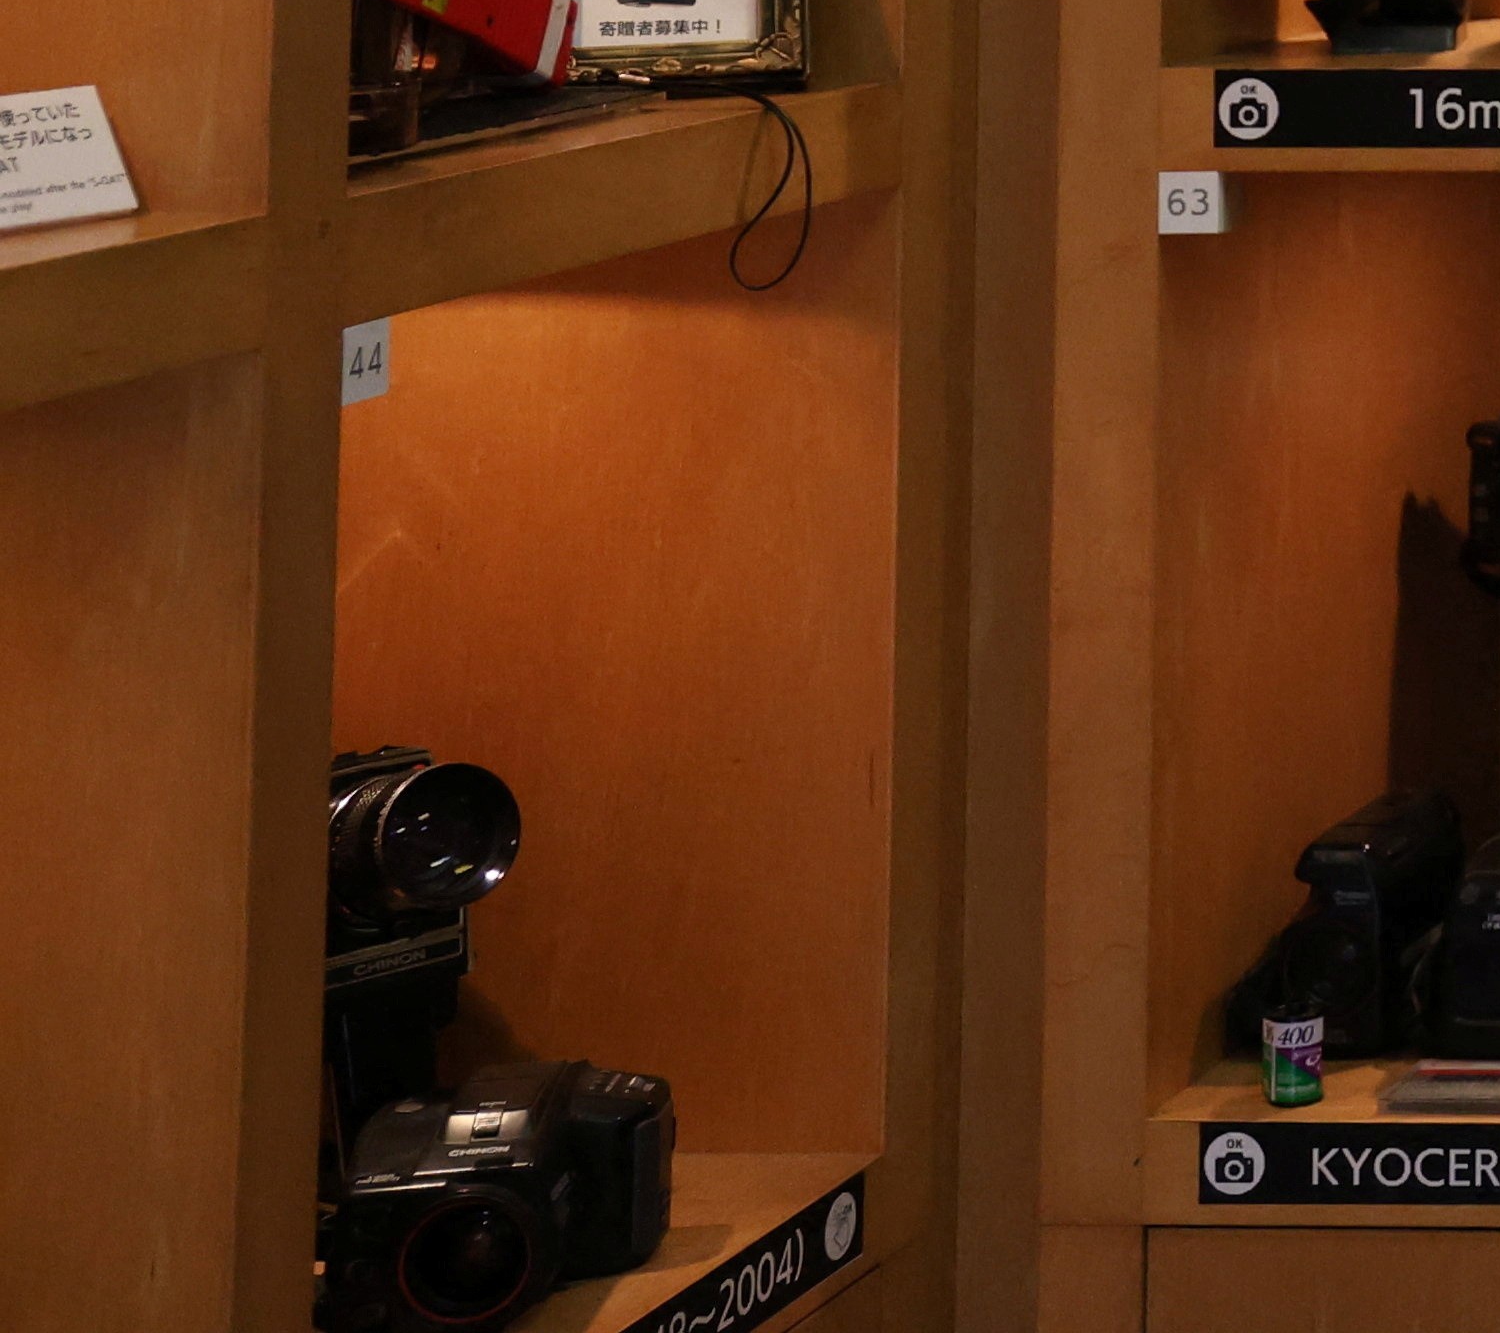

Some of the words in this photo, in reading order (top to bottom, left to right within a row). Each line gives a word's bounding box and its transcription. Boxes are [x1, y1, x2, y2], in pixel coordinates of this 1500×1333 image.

[1166, 189, 1211, 216] 63
[350, 344, 383, 379] 44
[353, 946, 427, 977] CHINON
[1276, 1024, 1315, 1047] 400
[448, 1144, 511, 1157] CHINON
